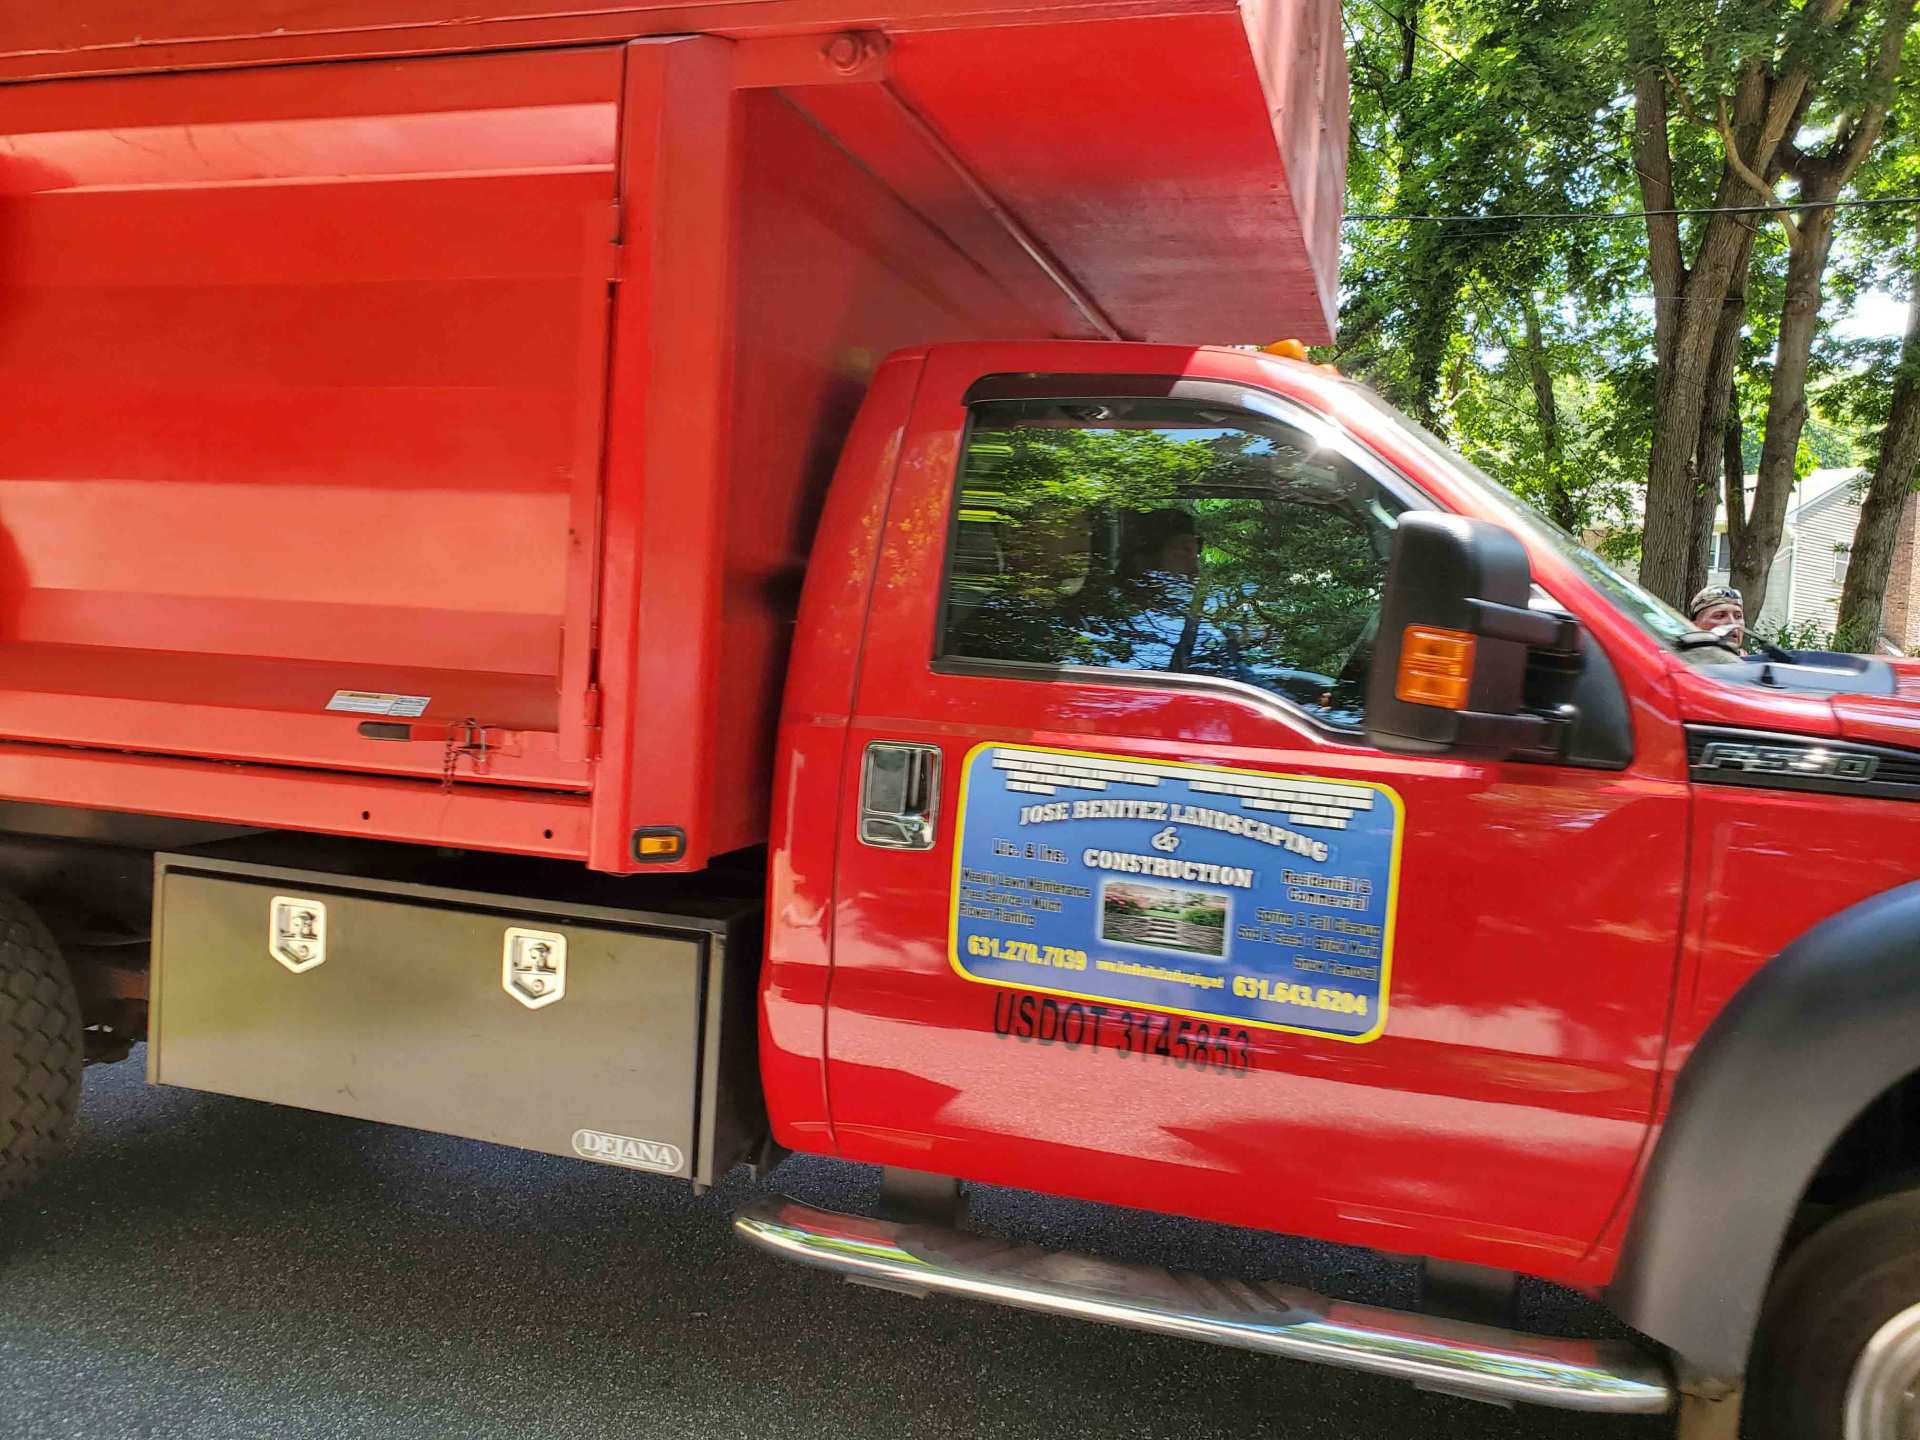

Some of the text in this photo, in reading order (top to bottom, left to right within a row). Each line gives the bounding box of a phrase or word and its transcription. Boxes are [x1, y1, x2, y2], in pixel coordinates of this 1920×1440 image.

[1019, 799, 1329, 862] JOSE BENITEZ LANDSCAPING
[1151, 826, 1180, 853] &
[1082, 848, 1252, 888] CONSTRUCTION
[994, 991, 1250, 1079] USDOT 3145853
[581, 1131, 676, 1166] DEJANA
